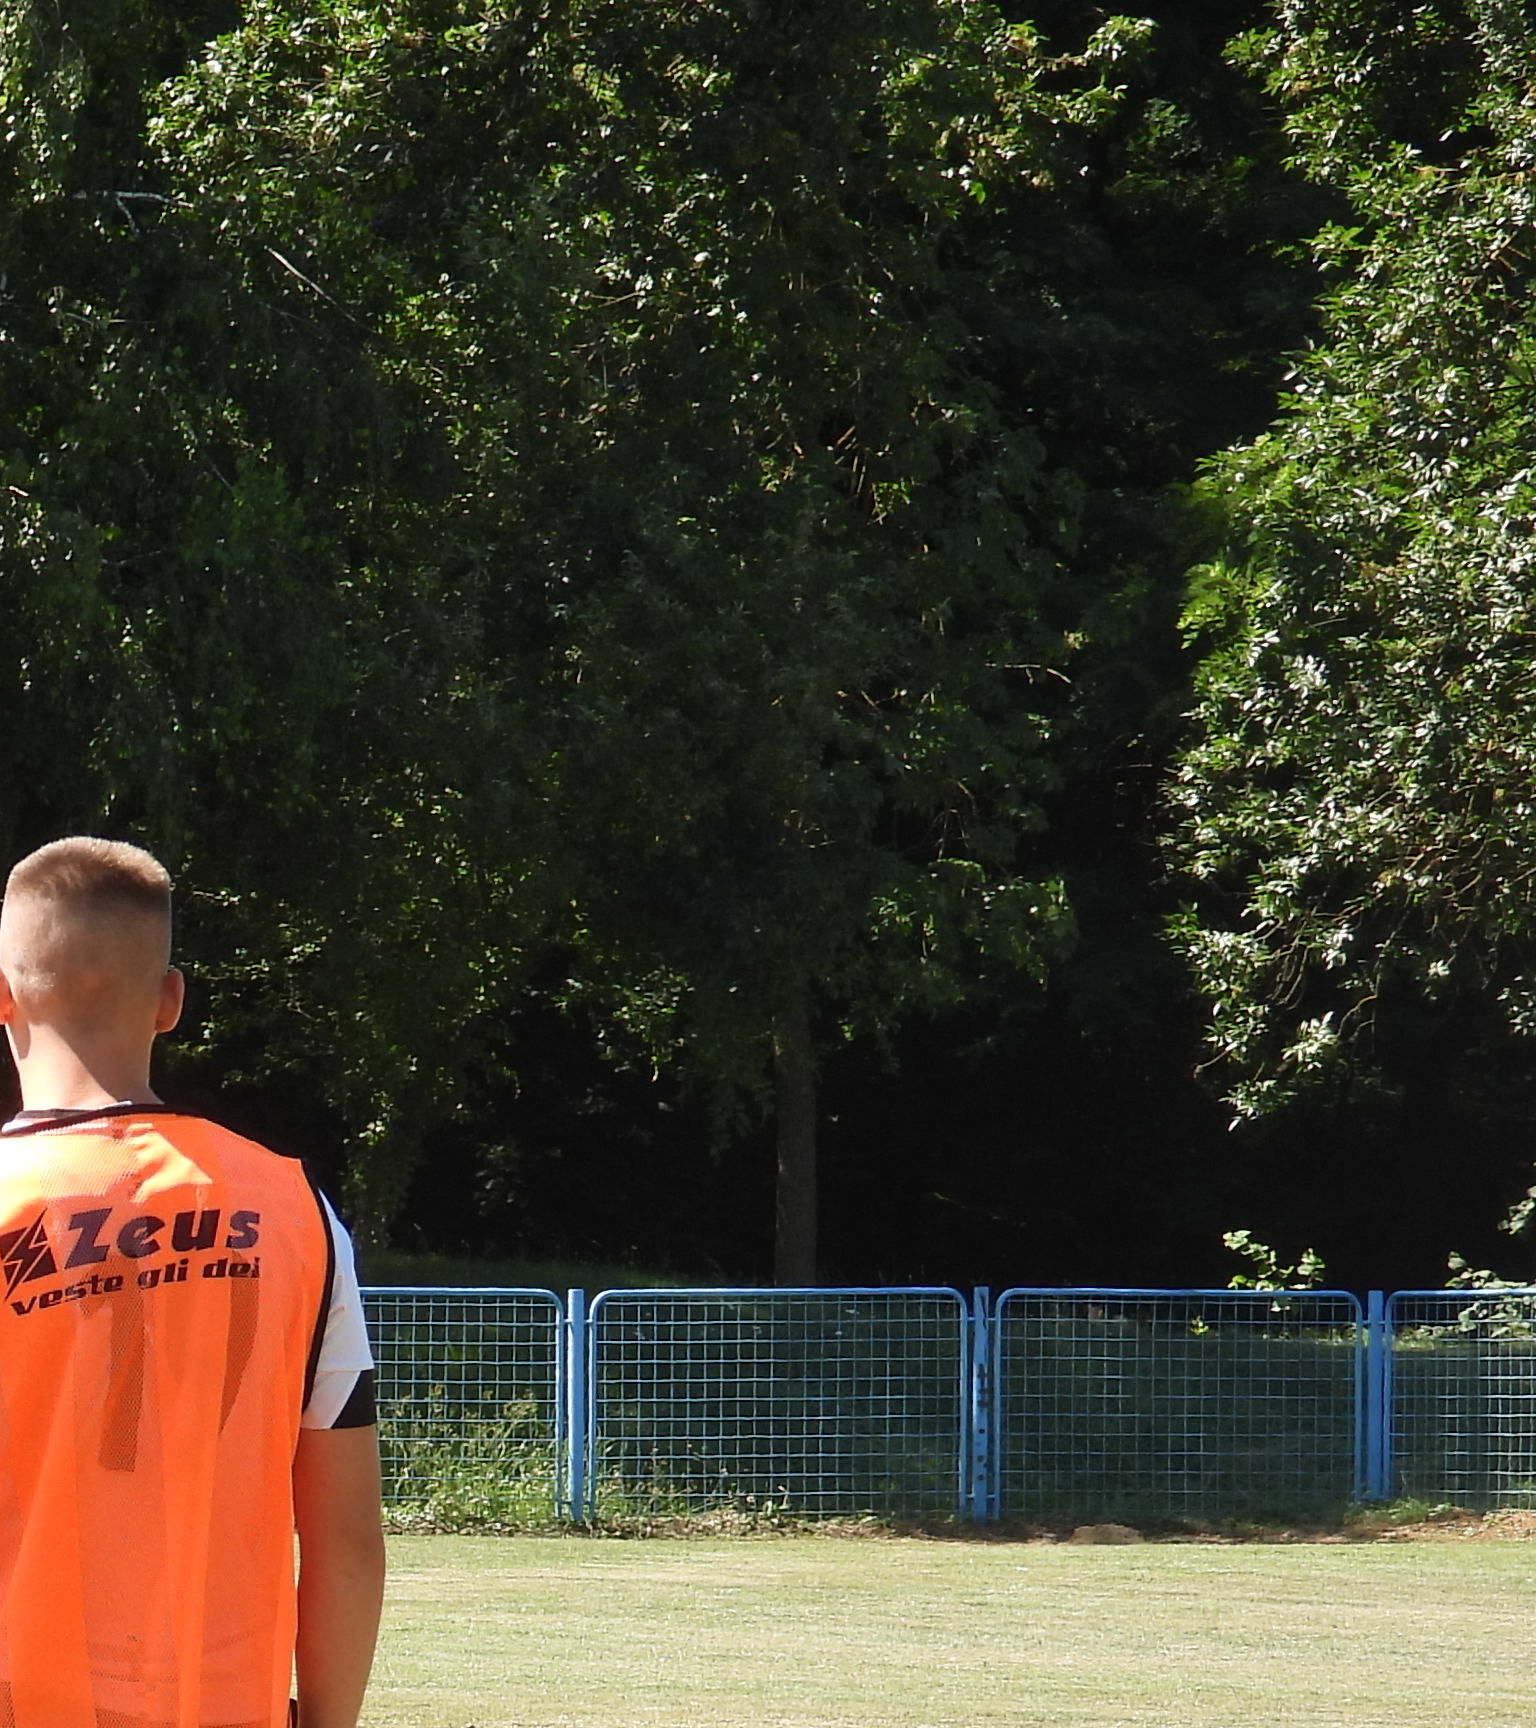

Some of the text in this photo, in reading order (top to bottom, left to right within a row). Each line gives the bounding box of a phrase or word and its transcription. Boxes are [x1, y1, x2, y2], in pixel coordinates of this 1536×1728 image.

[64, 1207, 260, 1270] Zeus
[11, 1256, 260, 1316] veste gli dei
